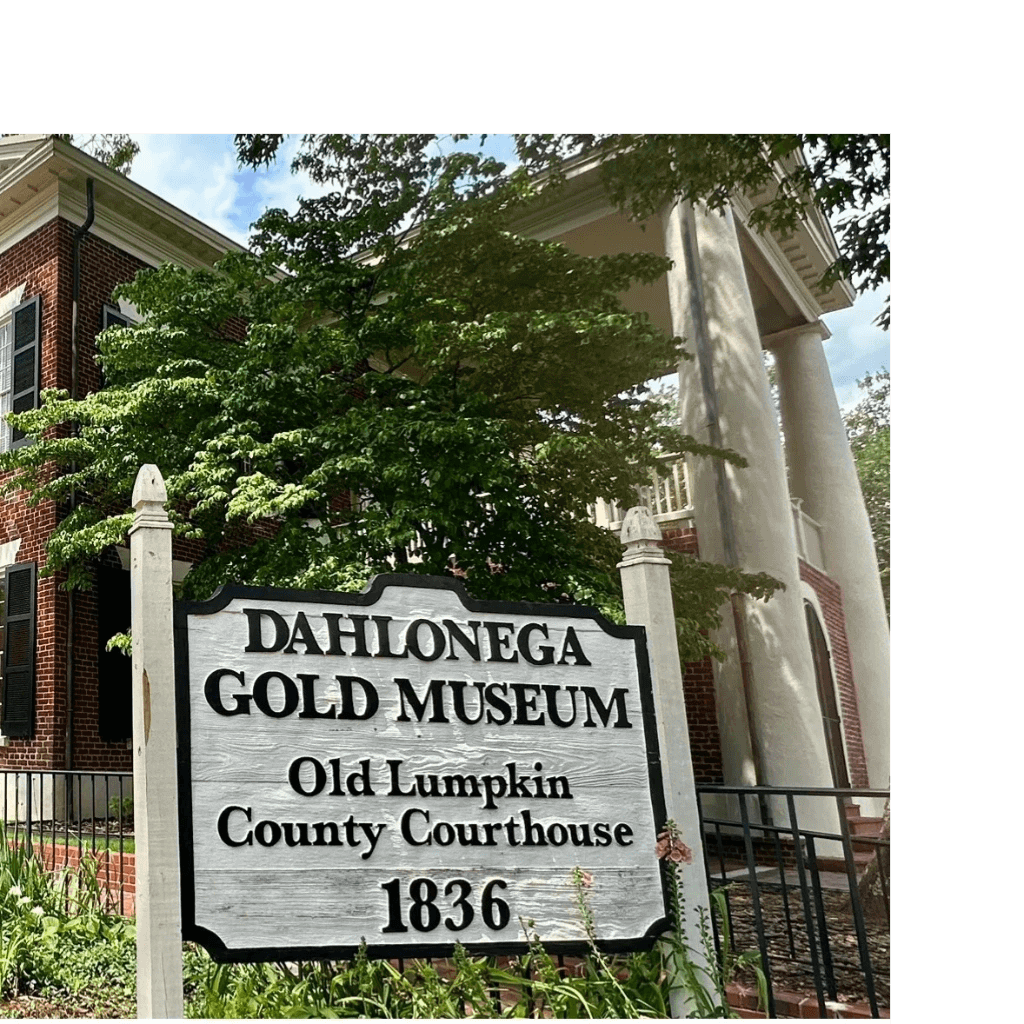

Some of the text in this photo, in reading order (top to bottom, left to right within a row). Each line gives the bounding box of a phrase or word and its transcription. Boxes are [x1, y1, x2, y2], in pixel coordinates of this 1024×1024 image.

[243, 609, 591, 666] DAHLONEGA
[205, 669, 632, 728] GOLD MUSEUM
[289, 757, 573, 809] Old Lumpkin
[218, 806, 633, 860] County Courthouse
[382, 879, 510, 933] 1836
